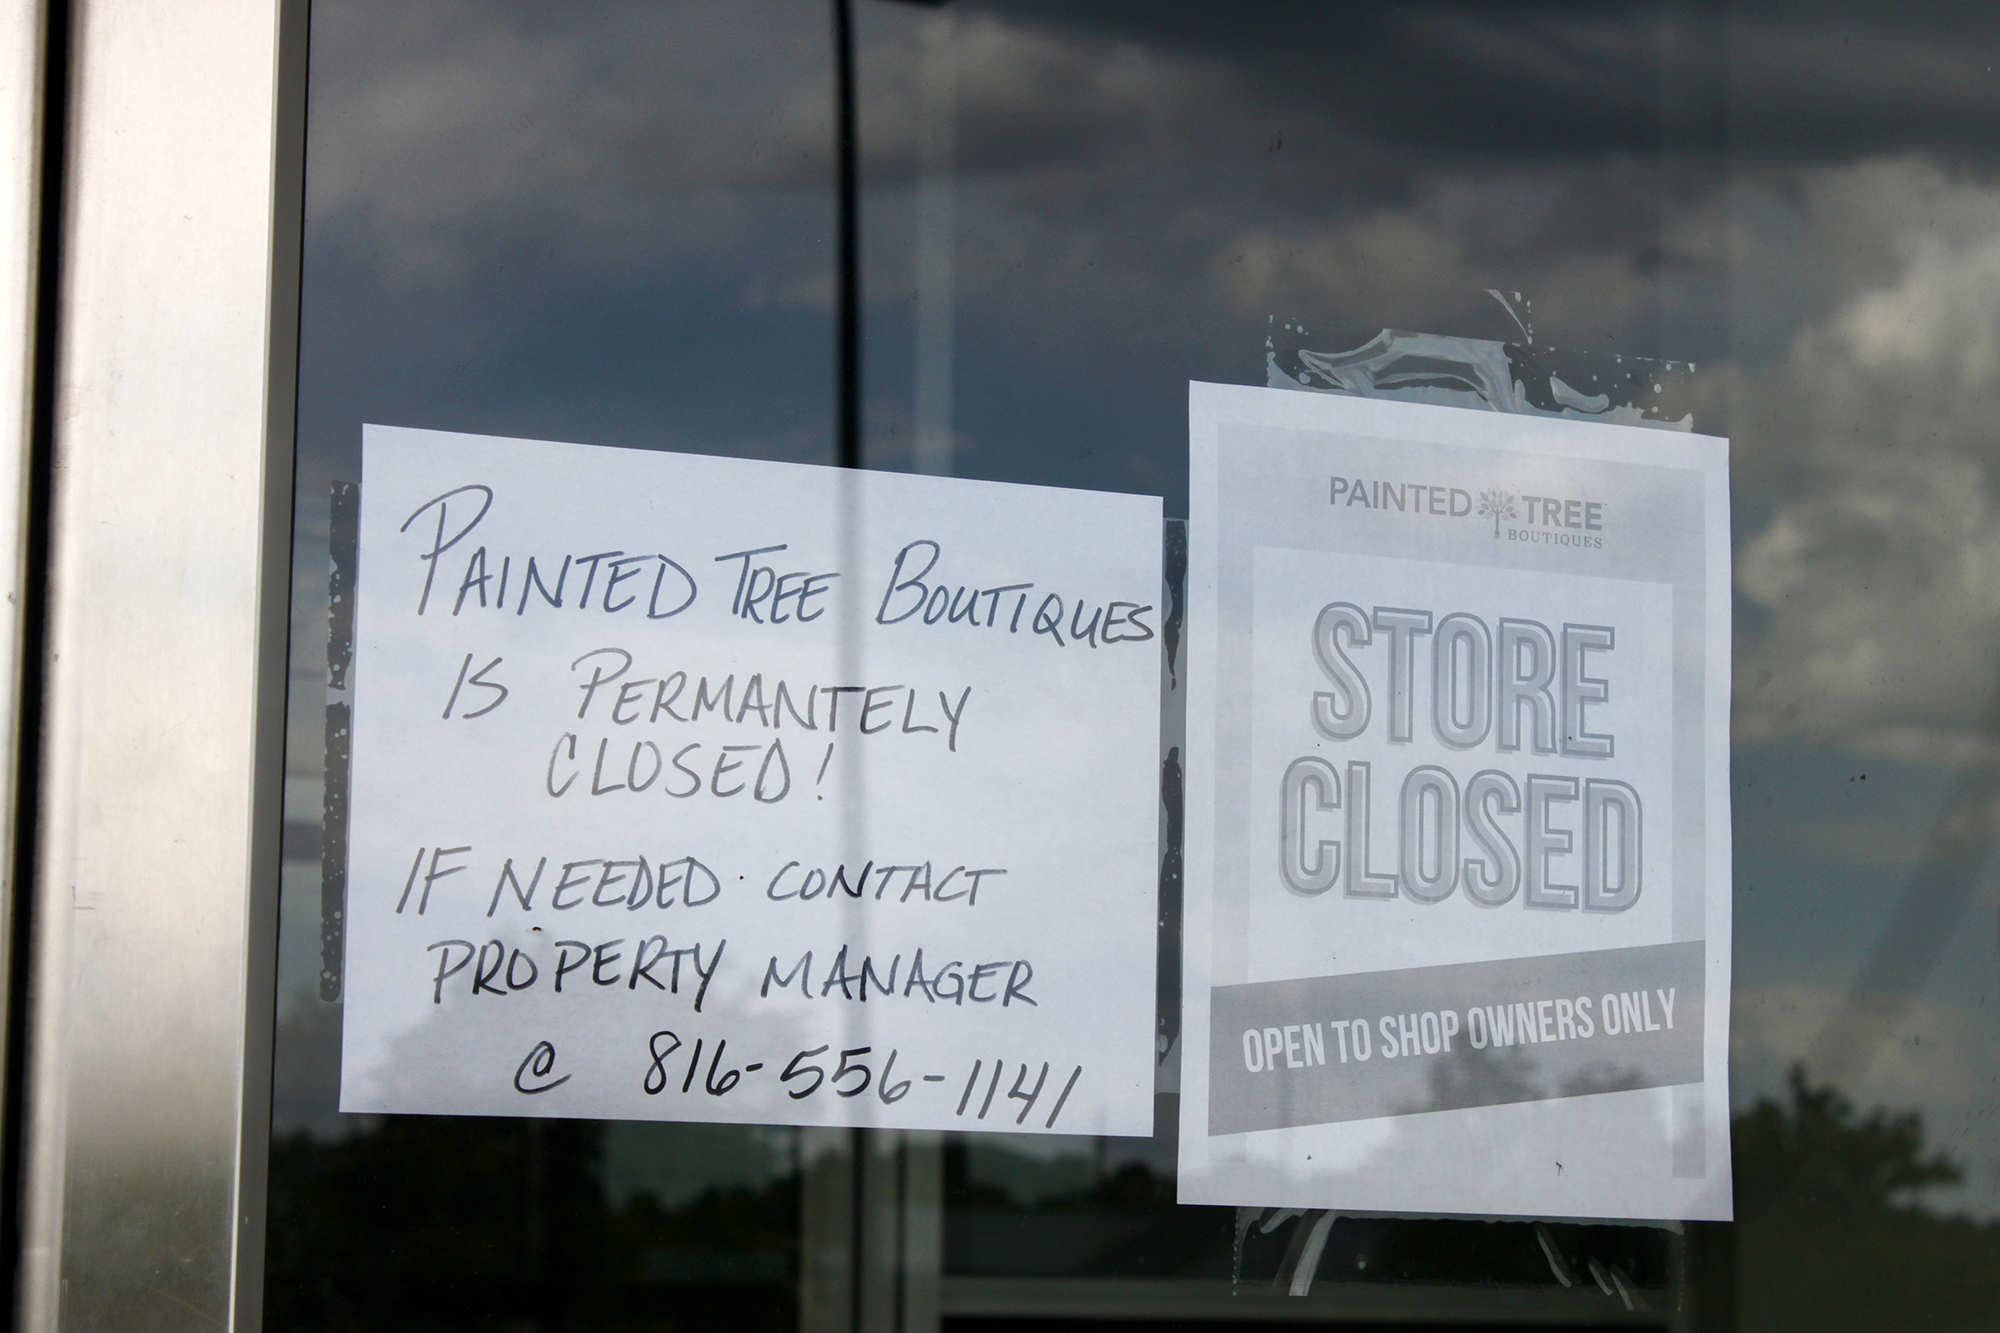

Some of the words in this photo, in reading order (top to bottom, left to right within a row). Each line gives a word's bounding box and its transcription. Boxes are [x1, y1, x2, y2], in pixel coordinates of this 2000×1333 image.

[1330, 476, 1473, 518] PAINTED
[1521, 495, 1603, 532] TREE
[1507, 528, 1603, 549] BOUTIQUES
[400, 484, 698, 617] PAINTED
[715, 543, 841, 624] TREE
[875, 539, 1156, 648] BOUTIQUES
[443, 653, 510, 720] IS
[571, 647, 971, 753] PERMANTELY
[1311, 601, 1615, 758] STORE
[546, 733, 834, 803] CLOSED!
[1279, 756, 1643, 914] CLOSED
[396, 845, 472, 915] IF
[486, 855, 721, 918] NEEDED
[766, 859, 1008, 908] CONTACT
[427, 934, 726, 1012] PROPERTY
[760, 944, 1037, 1007] MANAGER
[1242, 1023, 1326, 1073] OPEN
[1331, 1018, 1372, 1063] TO
[1379, 1010, 1460, 1059] SHOP
[1468, 996, 1596, 1051] OWNERS
[1602, 988, 1676, 1036] ONLY
[514, 1040, 572, 1093] @
[643, 1030, 1082, 1129] 816-556-1141
